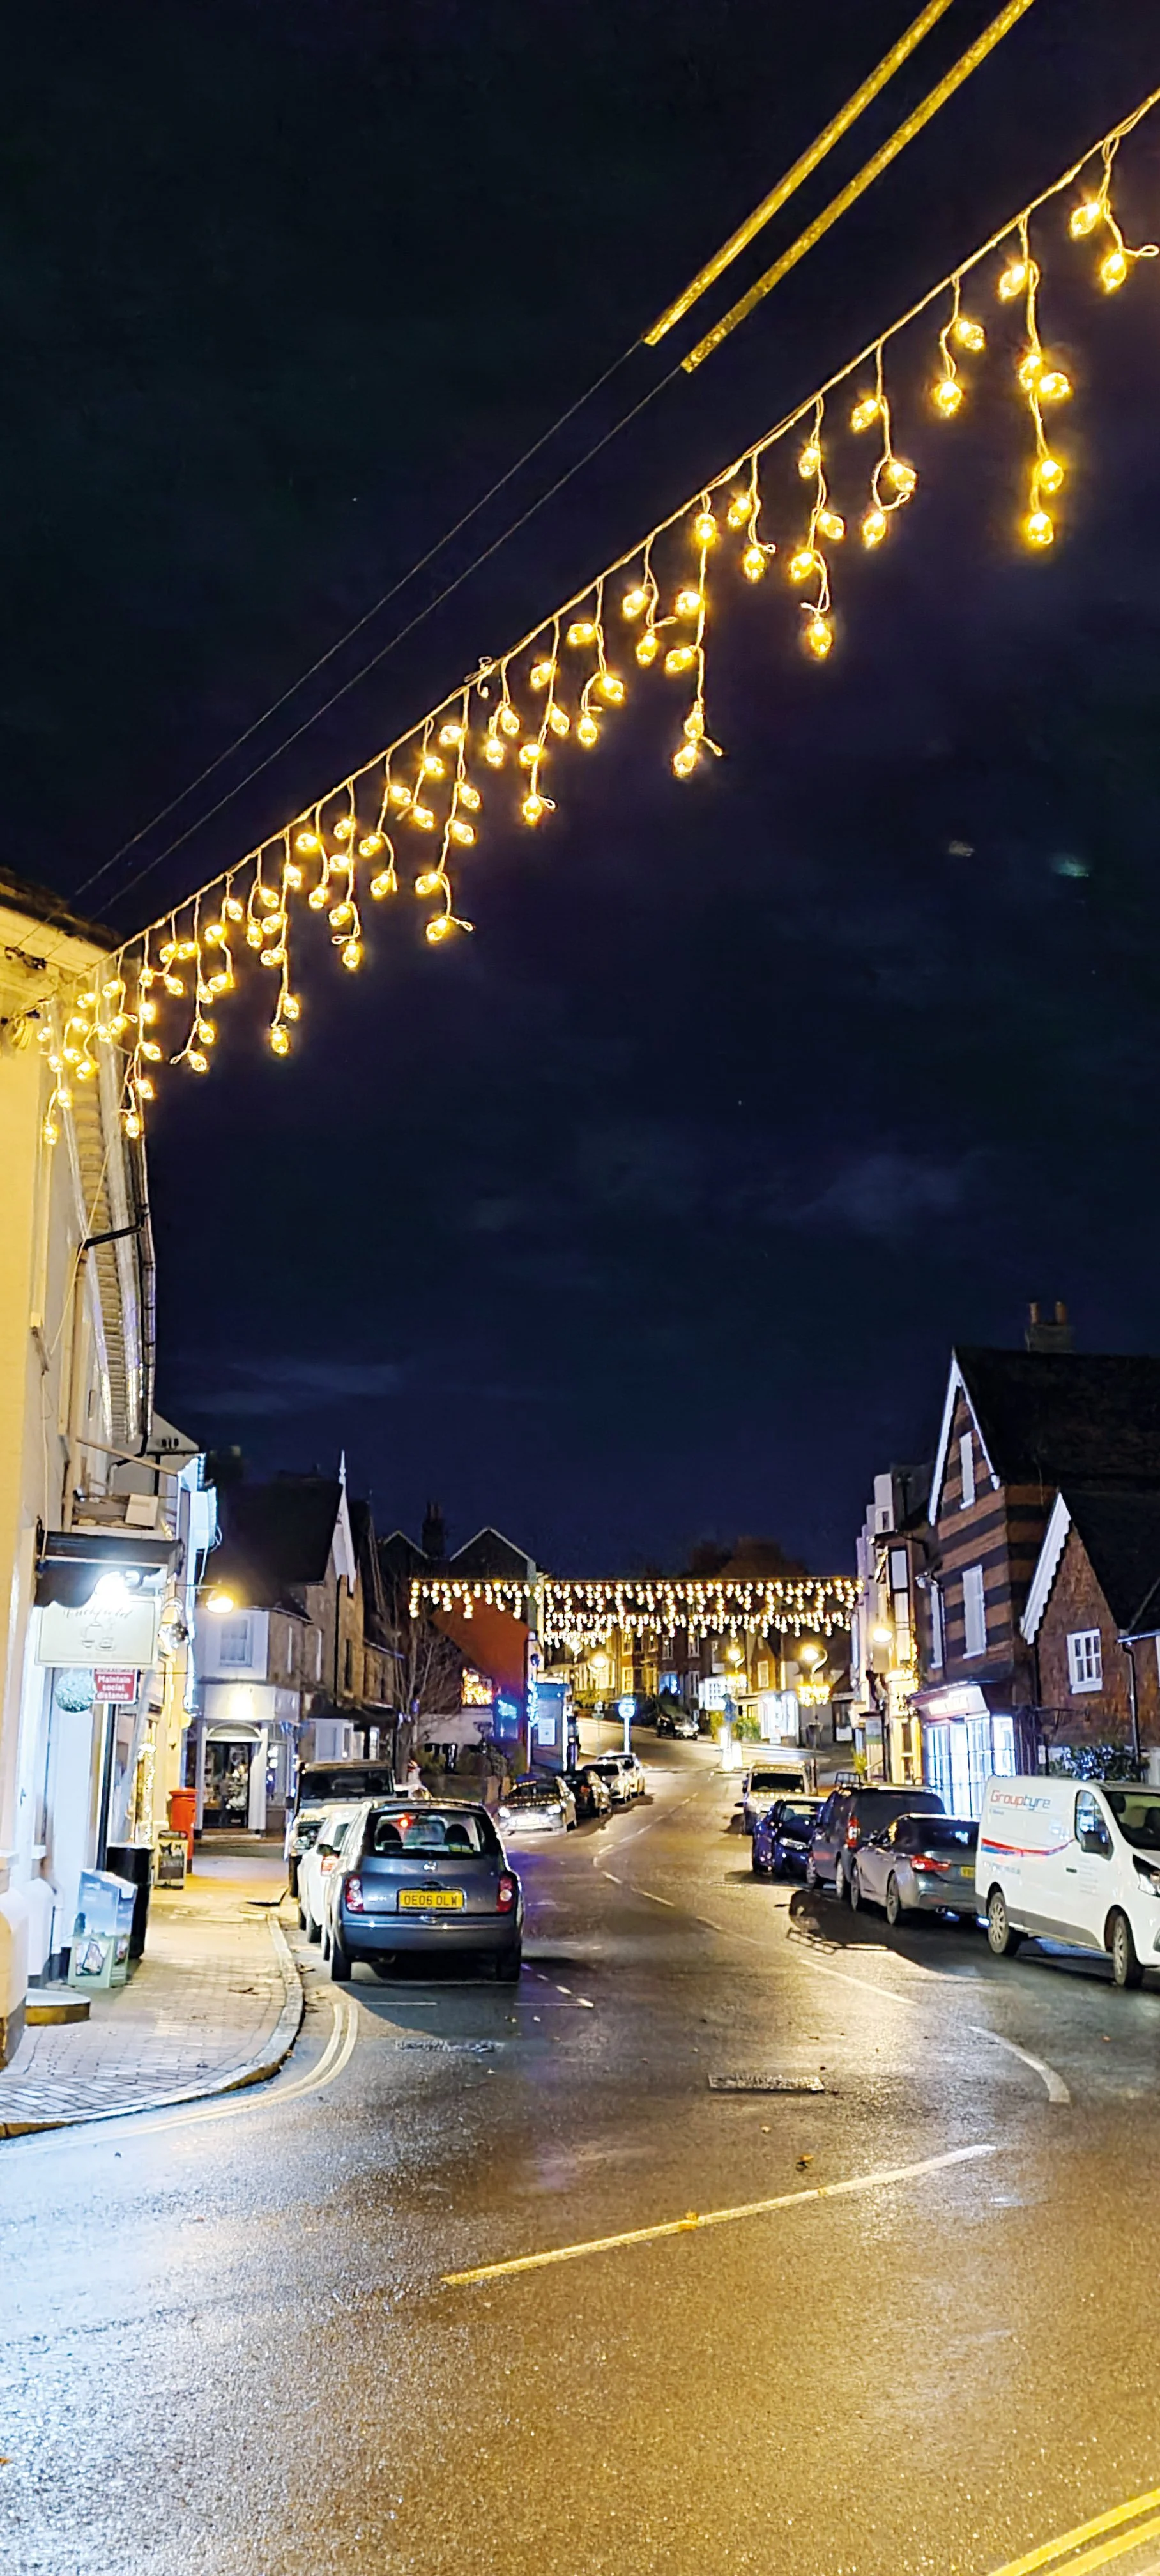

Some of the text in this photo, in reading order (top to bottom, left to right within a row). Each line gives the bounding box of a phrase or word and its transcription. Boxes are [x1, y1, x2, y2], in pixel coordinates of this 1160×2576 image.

[98, 1675, 131, 1683] Maintain
[102, 1683, 125, 1692] social
[96, 1692, 129, 1700] distance
[991, 1790, 1051, 1811] Grouptyre
